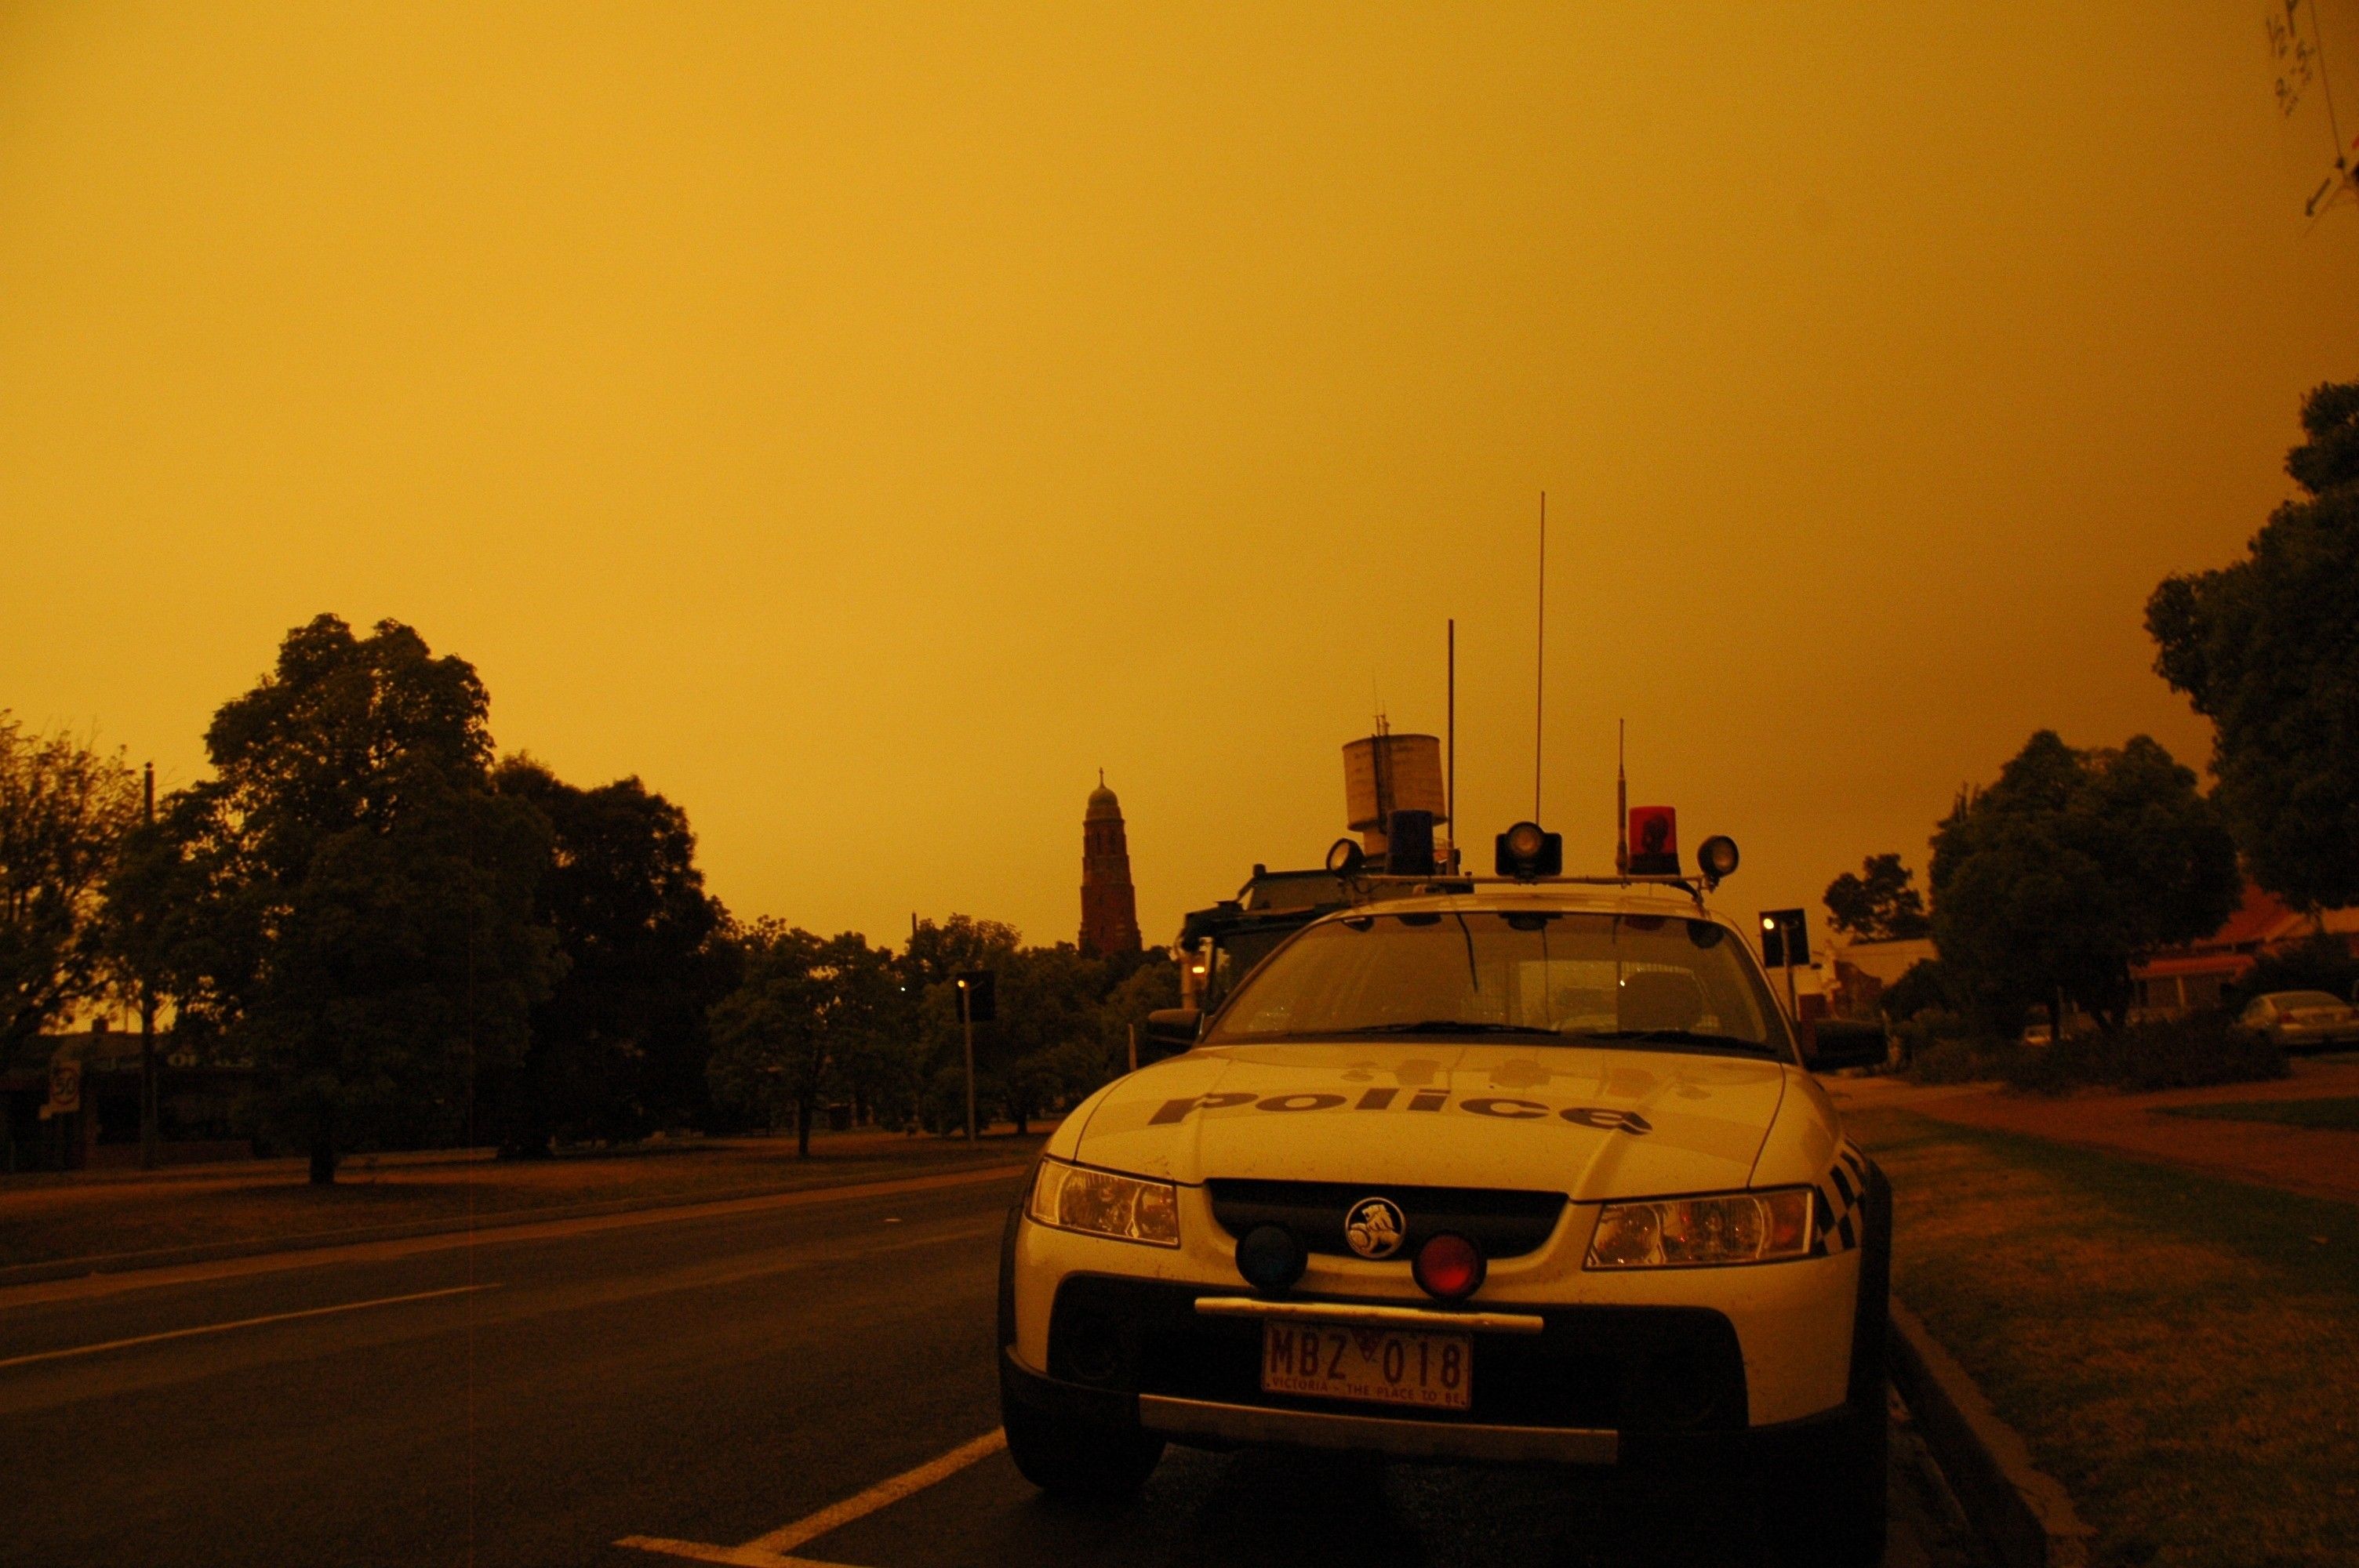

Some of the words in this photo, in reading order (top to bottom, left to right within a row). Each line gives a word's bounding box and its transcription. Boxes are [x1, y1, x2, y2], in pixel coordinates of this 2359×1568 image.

[1147, 1087, 1653, 1136] police
[1270, 1329, 1347, 1381] MBZ
[1383, 1338, 1461, 1388] 018
[1272, 1376, 1329, 1392] VICTORIA
[1347, 1383, 1369, 1396] THE
[1376, 1386, 1413, 1400] PLACE
[1421, 1389, 1438, 1402] TO
